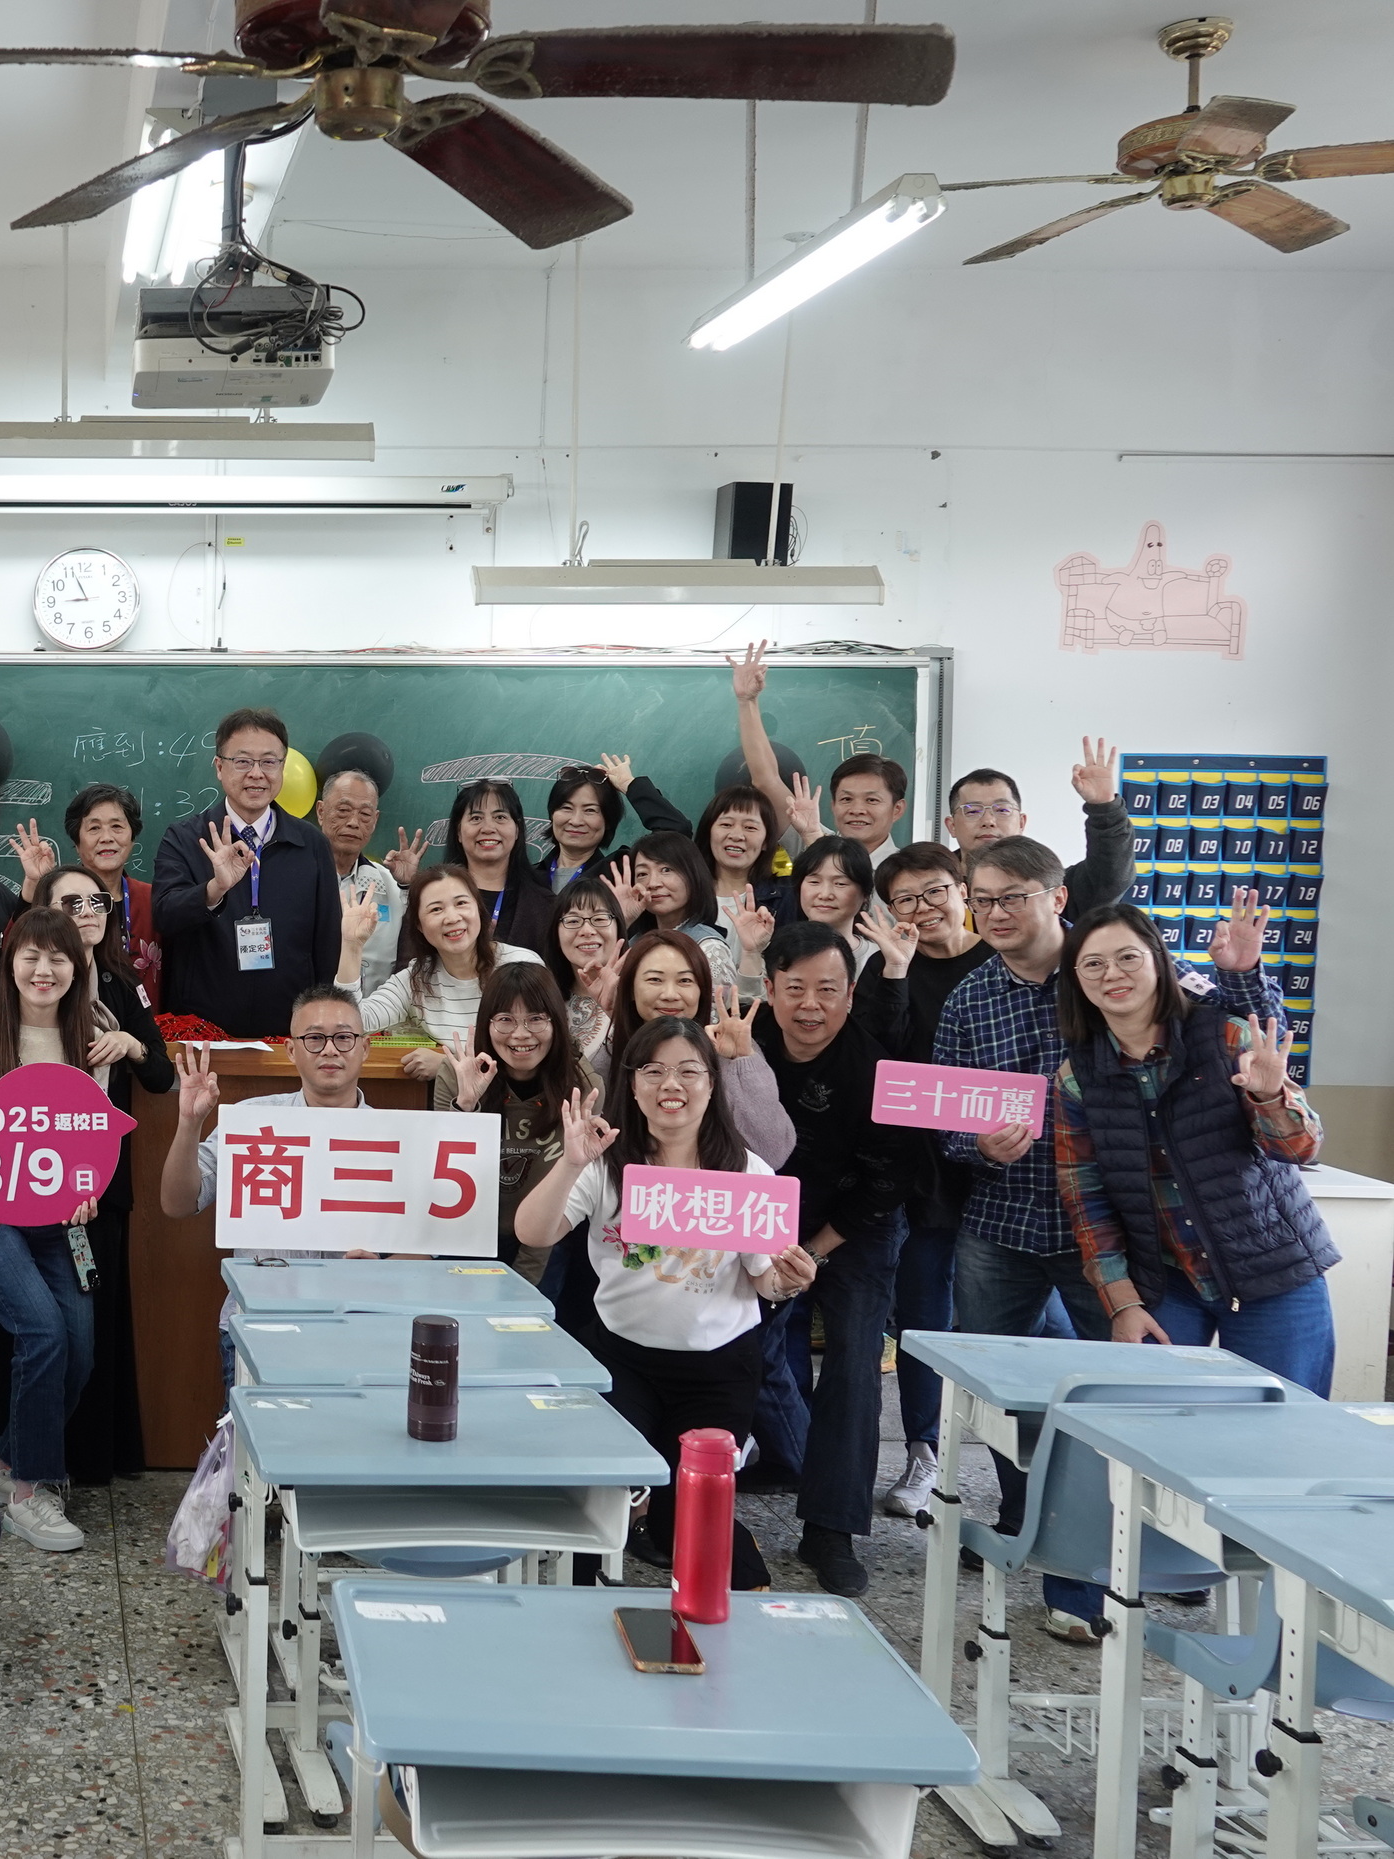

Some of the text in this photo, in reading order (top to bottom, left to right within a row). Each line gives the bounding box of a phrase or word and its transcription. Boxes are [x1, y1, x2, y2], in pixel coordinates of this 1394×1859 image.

[63, 566, 74, 578] 11
[77, 562, 93, 573] 12
[101, 564, 106, 576] 1
[51, 579, 65, 592] 10
[111, 574, 121, 587] 2
[46, 596, 56, 608] 9
[117, 590, 127, 603] 3
[53, 612, 63, 625] 8
[113, 608, 123, 620] 4
[66, 622, 76, 635] 7
[84, 626, 94, 639] 6
[102, 620, 112, 633] 5
[1133, 794, 1152, 809] 01
[1168, 794, 1188, 809] 02
[1201, 795, 1221, 810] 03
[1234, 794, 1254, 809] 04
[1267, 795, 1287, 810] 05
[1302, 795, 1322, 811] 06
[1133, 838, 1152, 853] 07
[1165, 838, 1184, 853] 08
[1199, 839, 1218, 854] 09
[1234, 840, 1252, 854] 10
[1268, 841, 1284, 855] 11
[1300, 840, 1318, 855] 12
[1131, 884, 1149, 899] 13
[1164, 884, 1183, 899] 14
[1197, 884, 1215, 899] 15
[1264, 885, 1285, 900] 17
[1298, 886, 1317, 901] 18
[1161, 928, 1180, 943] 20
[1196, 929, 1213, 943] 21
[1262, 929, 1281, 944] 23
[1293, 930, 1313, 945] 24
[1290, 976, 1310, 990] 30
[1291, 1020, 1310, 1034] 36
[1288, 1065, 1305, 1079] 42
[881, 1080, 1036, 1126] 三十而麗
[54, 1113, 109, 1131] 返校日
[225, 1125, 477, 1220] 商三5
[75, 1170, 94, 1191] 日
[629, 1183, 791, 1240] 啾想你
